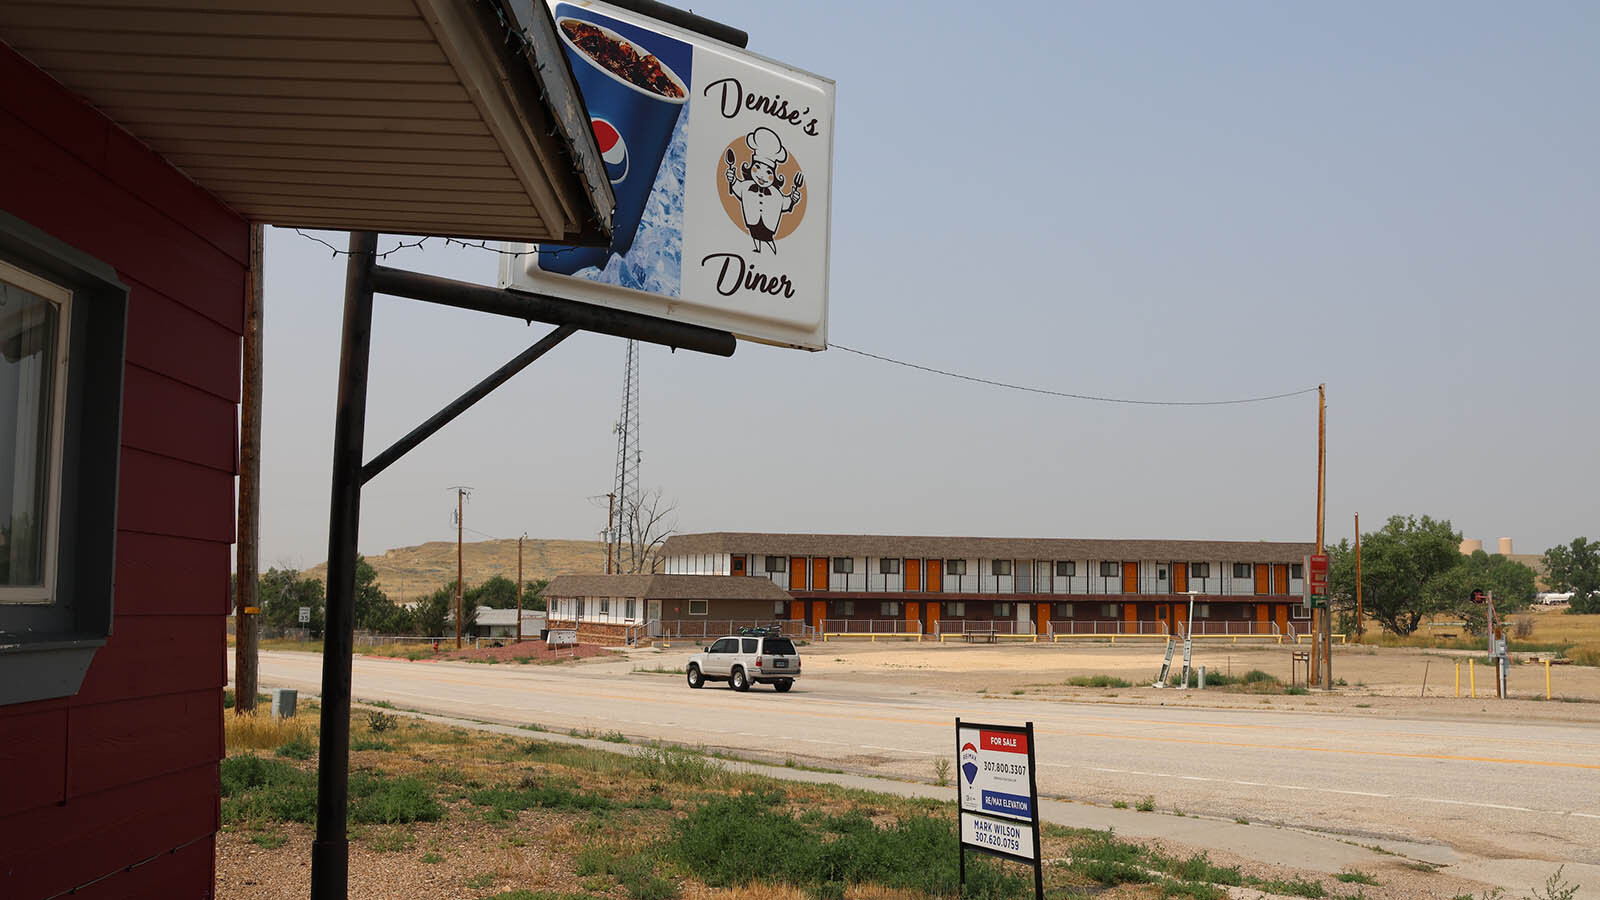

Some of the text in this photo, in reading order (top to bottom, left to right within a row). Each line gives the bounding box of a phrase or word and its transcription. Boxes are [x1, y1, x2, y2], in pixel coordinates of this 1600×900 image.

[704, 78, 819, 136] Denise's
[701, 253, 795, 299] Diner
[990, 736, 1017, 747] FOR SALE
[983, 761, 1026, 776] 307.800.3307
[985, 795, 1002, 807] RE/MAX
[1003, 798, 1028, 811] ELEVATION
[974, 820, 1020, 839] MARK WILSON
[975, 831, 1020, 851] 307.620.0759
